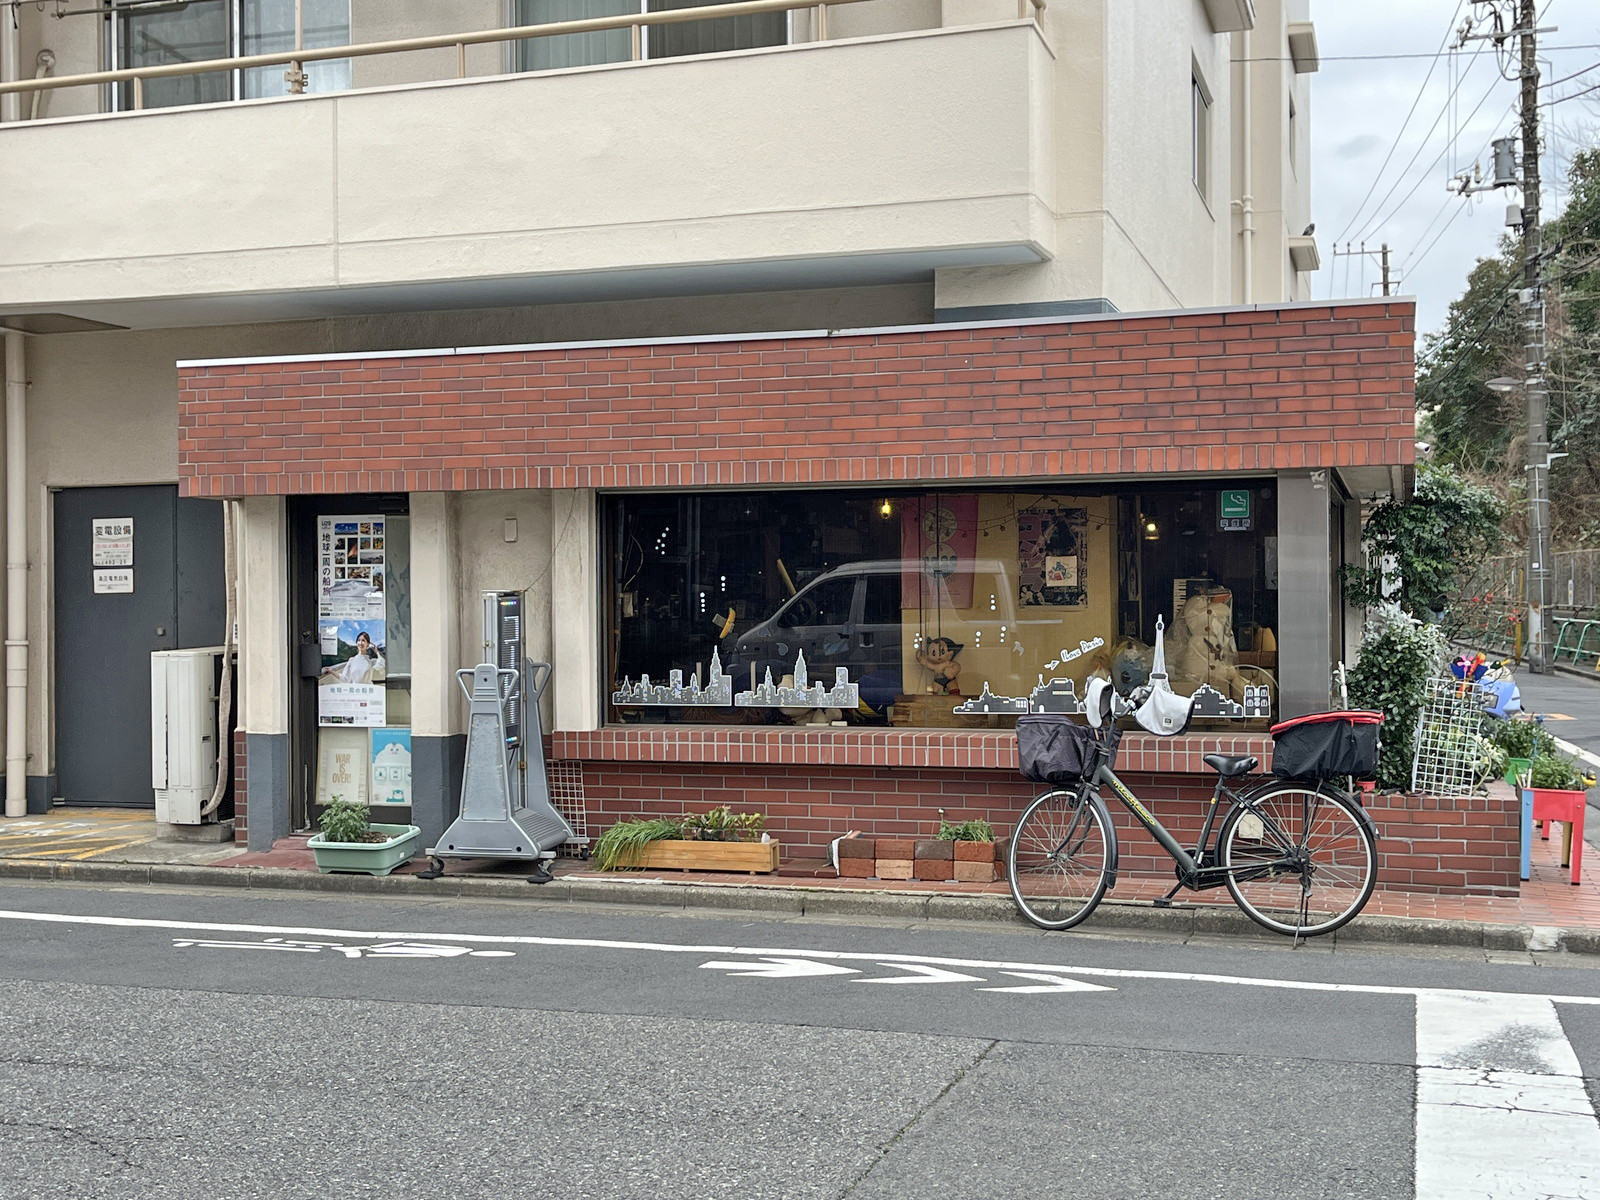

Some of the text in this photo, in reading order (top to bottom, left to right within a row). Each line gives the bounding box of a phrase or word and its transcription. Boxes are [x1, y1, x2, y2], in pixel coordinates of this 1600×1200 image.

[94, 525, 131, 536] 変電設備
[322, 533, 331, 597] 地球一周の船旅
[1081, 638, 1103, 652] Paris
[335, 753, 351, 764] WAR
[339, 763, 346, 774] IS
[332, 773, 351, 783] OVER!
